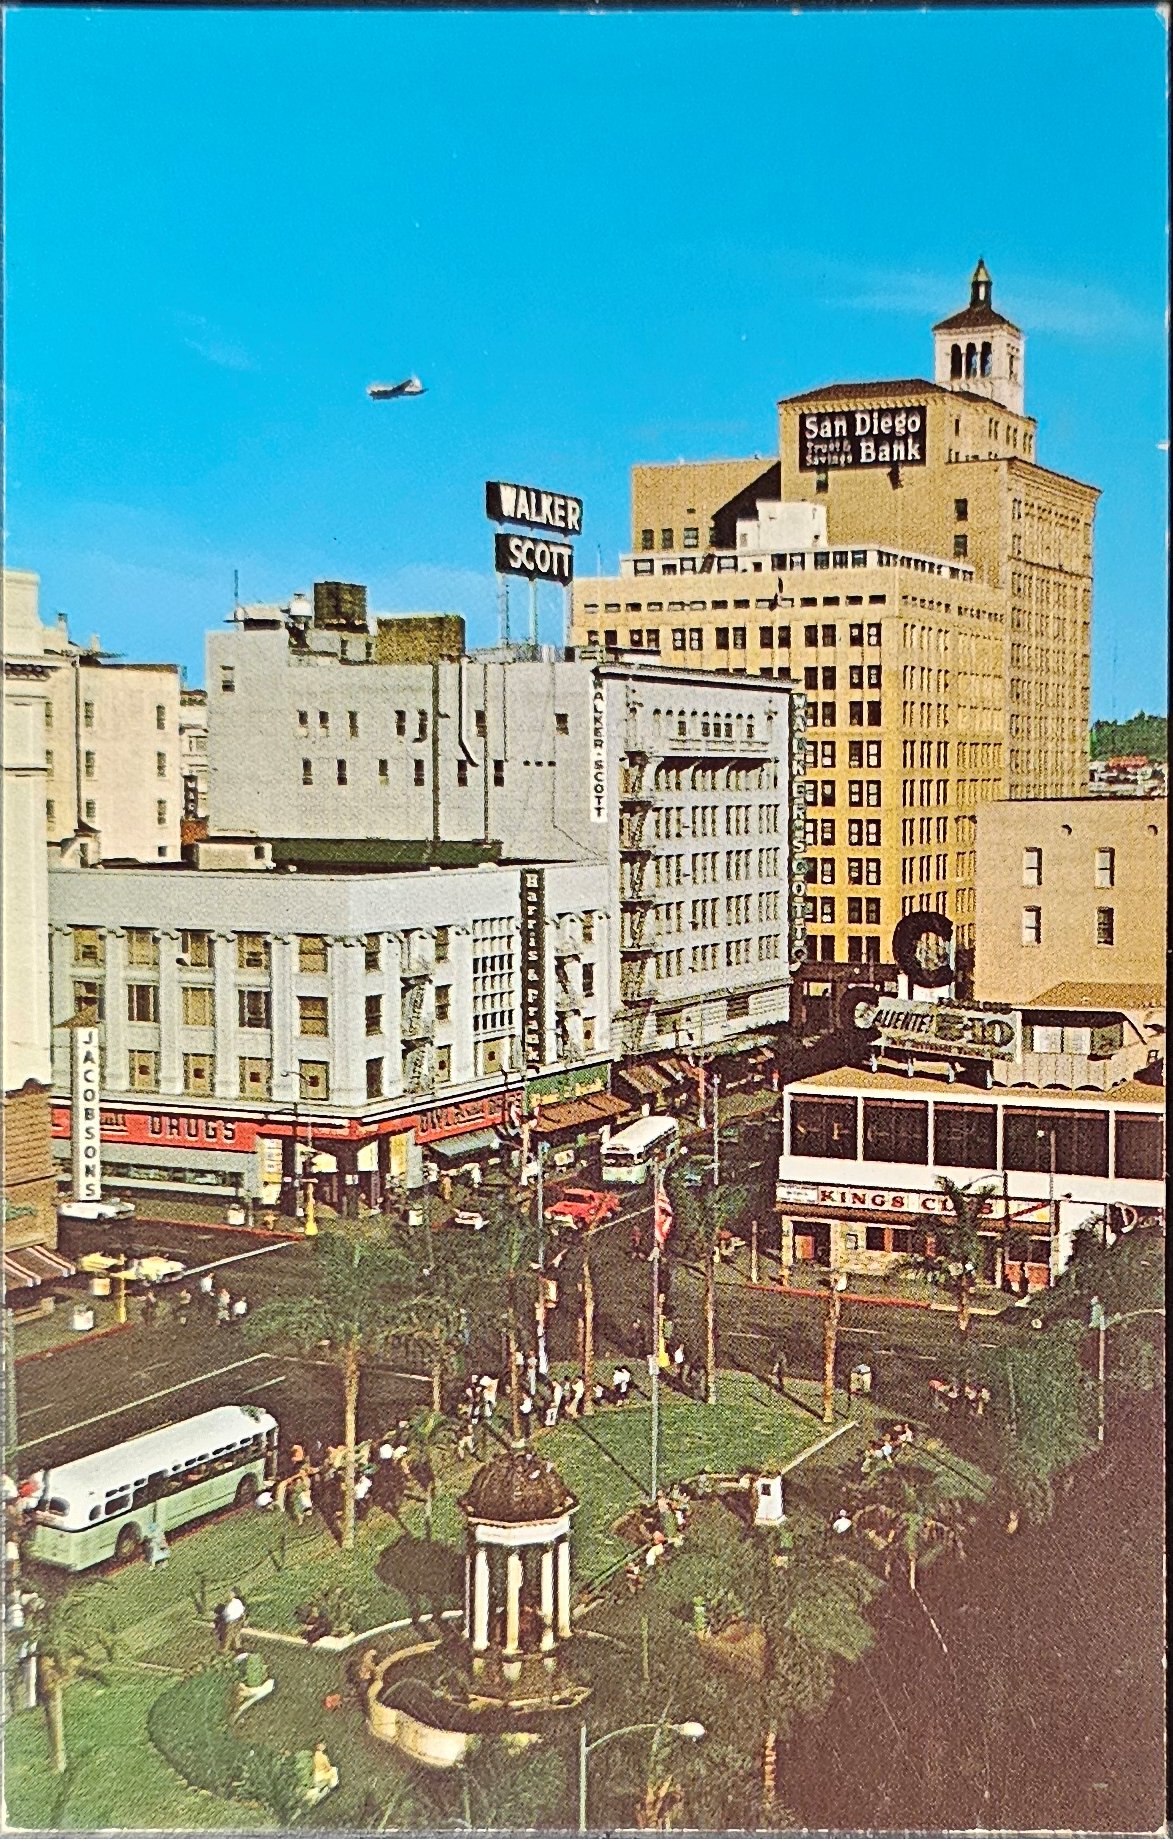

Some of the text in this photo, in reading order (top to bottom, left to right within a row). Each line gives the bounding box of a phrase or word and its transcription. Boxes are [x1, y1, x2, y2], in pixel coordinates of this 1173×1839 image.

[805, 410, 921, 439] San Diego
[859, 435, 921, 463] Bank
[500, 484, 580, 531] WALKER
[508, 537, 572, 577] SCOTT
[83, 1030, 97, 1198] JACOBSONS
[148, 1114, 238, 1144] DRUGS
[819, 1188, 906, 1210] KINGS
